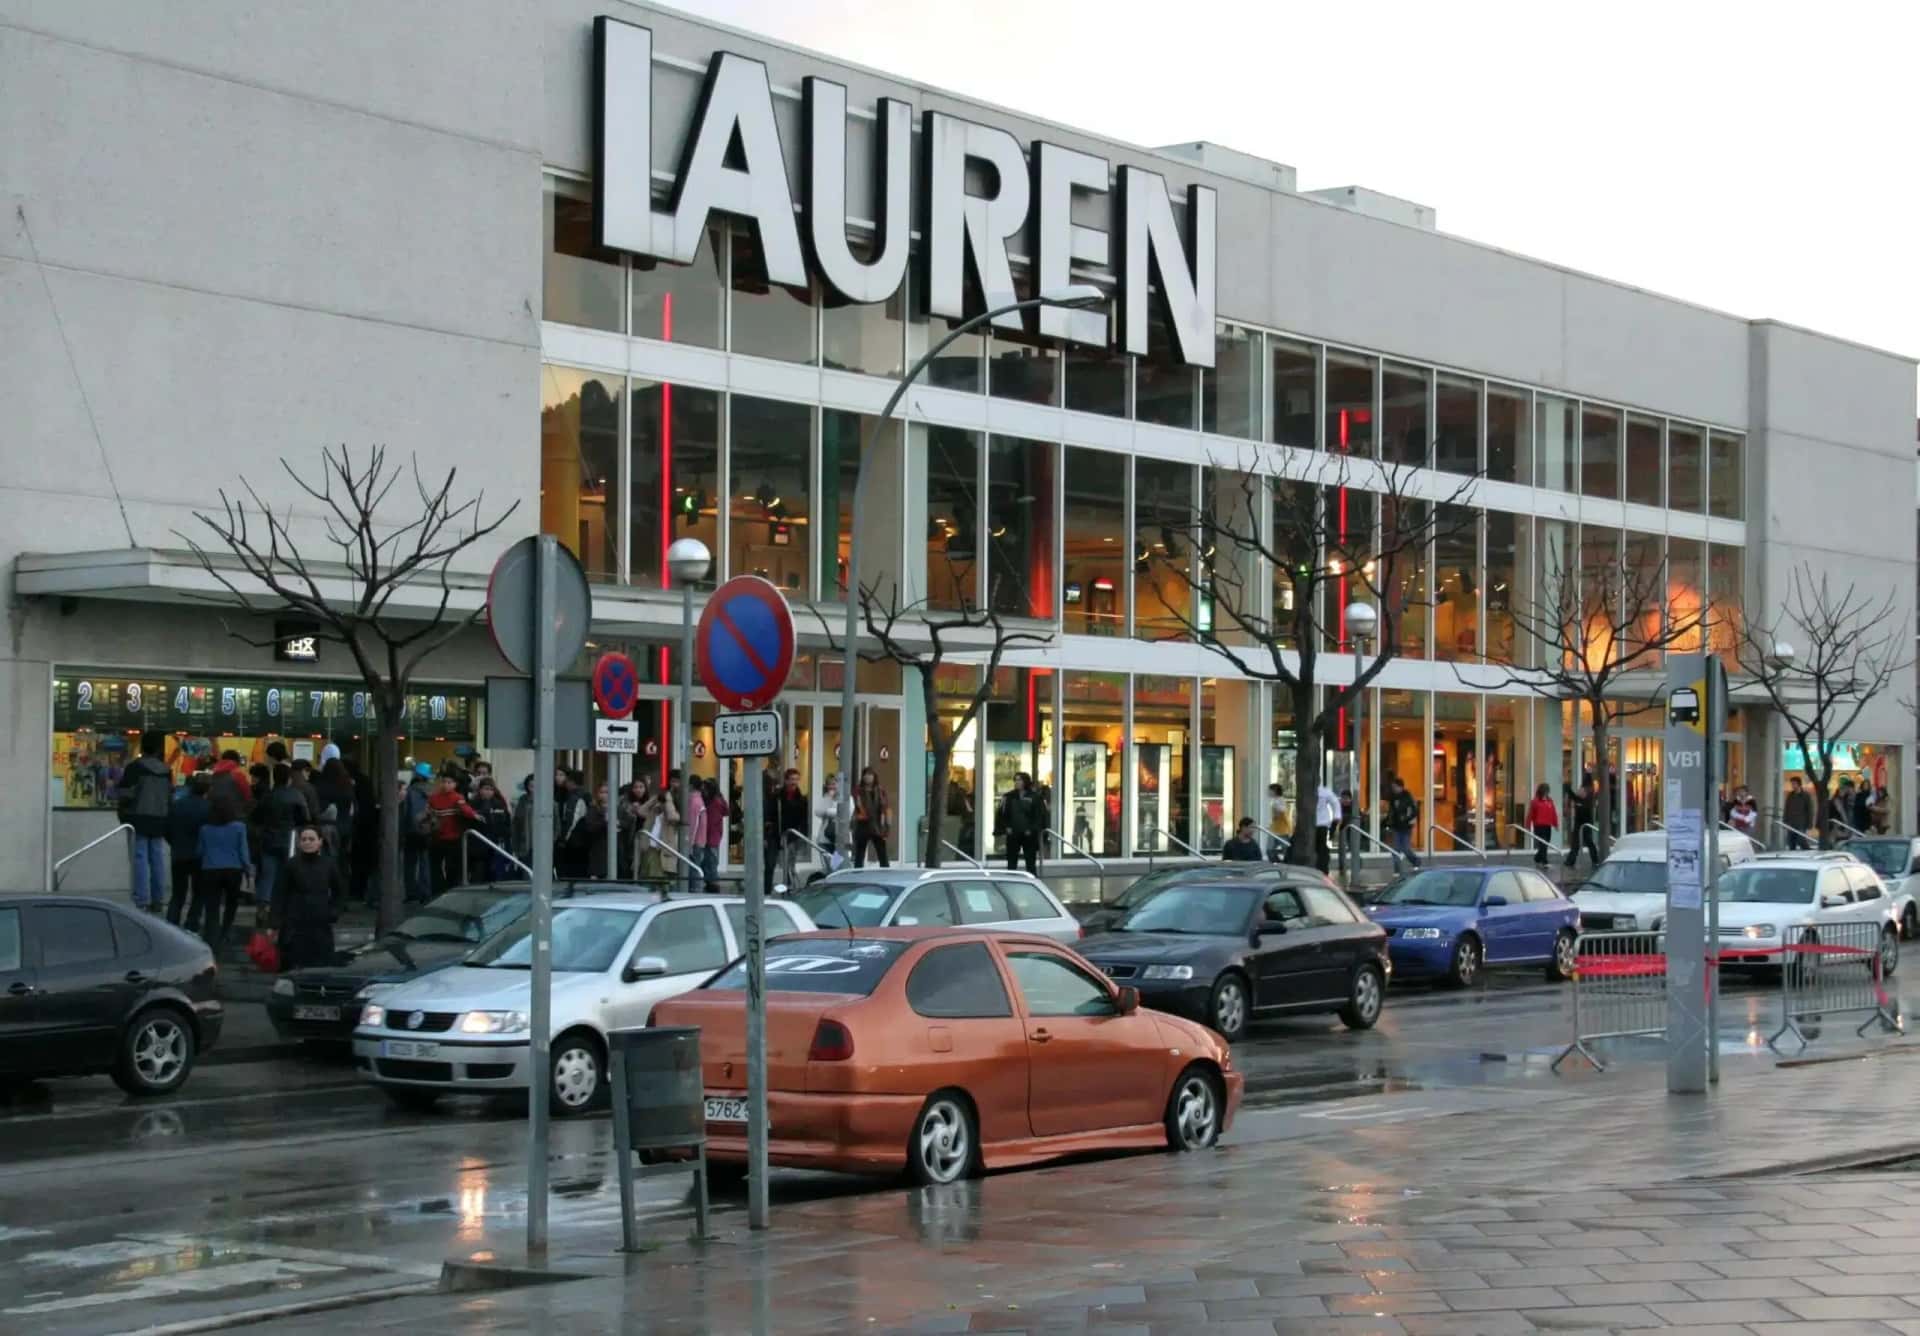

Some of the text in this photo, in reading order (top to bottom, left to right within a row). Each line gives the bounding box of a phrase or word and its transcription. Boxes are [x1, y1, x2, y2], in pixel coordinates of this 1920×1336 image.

[593, 15, 1217, 368] LAUREN
[77, 681, 92, 710] 2
[126, 683, 142, 712] 3
[174, 686, 189, 714] 4
[221, 687, 236, 715] 5
[266, 688, 280, 717] 6
[310, 691, 323, 718] 7
[352, 692, 365, 719] 8
[429, 696, 446, 720] 10
[722, 720, 769, 735] Excepte
[720, 738, 773, 751] Turismes
[1668, 751, 1701, 767] VB1
[706, 1100, 741, 1119] 5762
